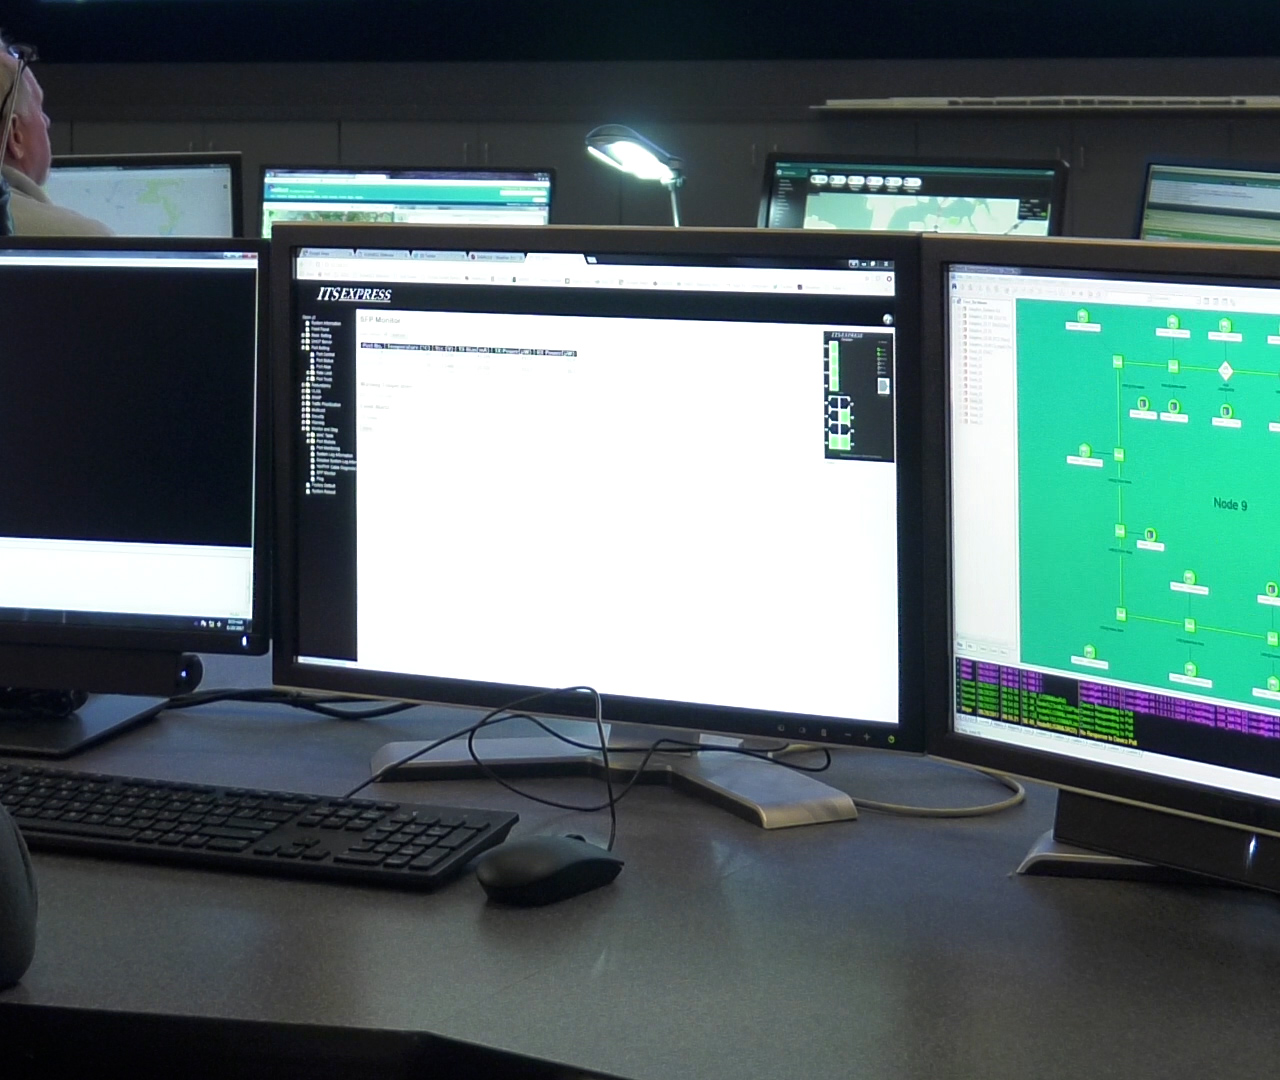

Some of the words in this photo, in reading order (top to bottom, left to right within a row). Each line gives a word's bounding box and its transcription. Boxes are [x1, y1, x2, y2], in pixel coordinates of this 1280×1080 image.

[375, 316, 401, 324] Monitor
[1213, 497, 1239, 511] Node
[1241, 501, 1248, 511] 9
